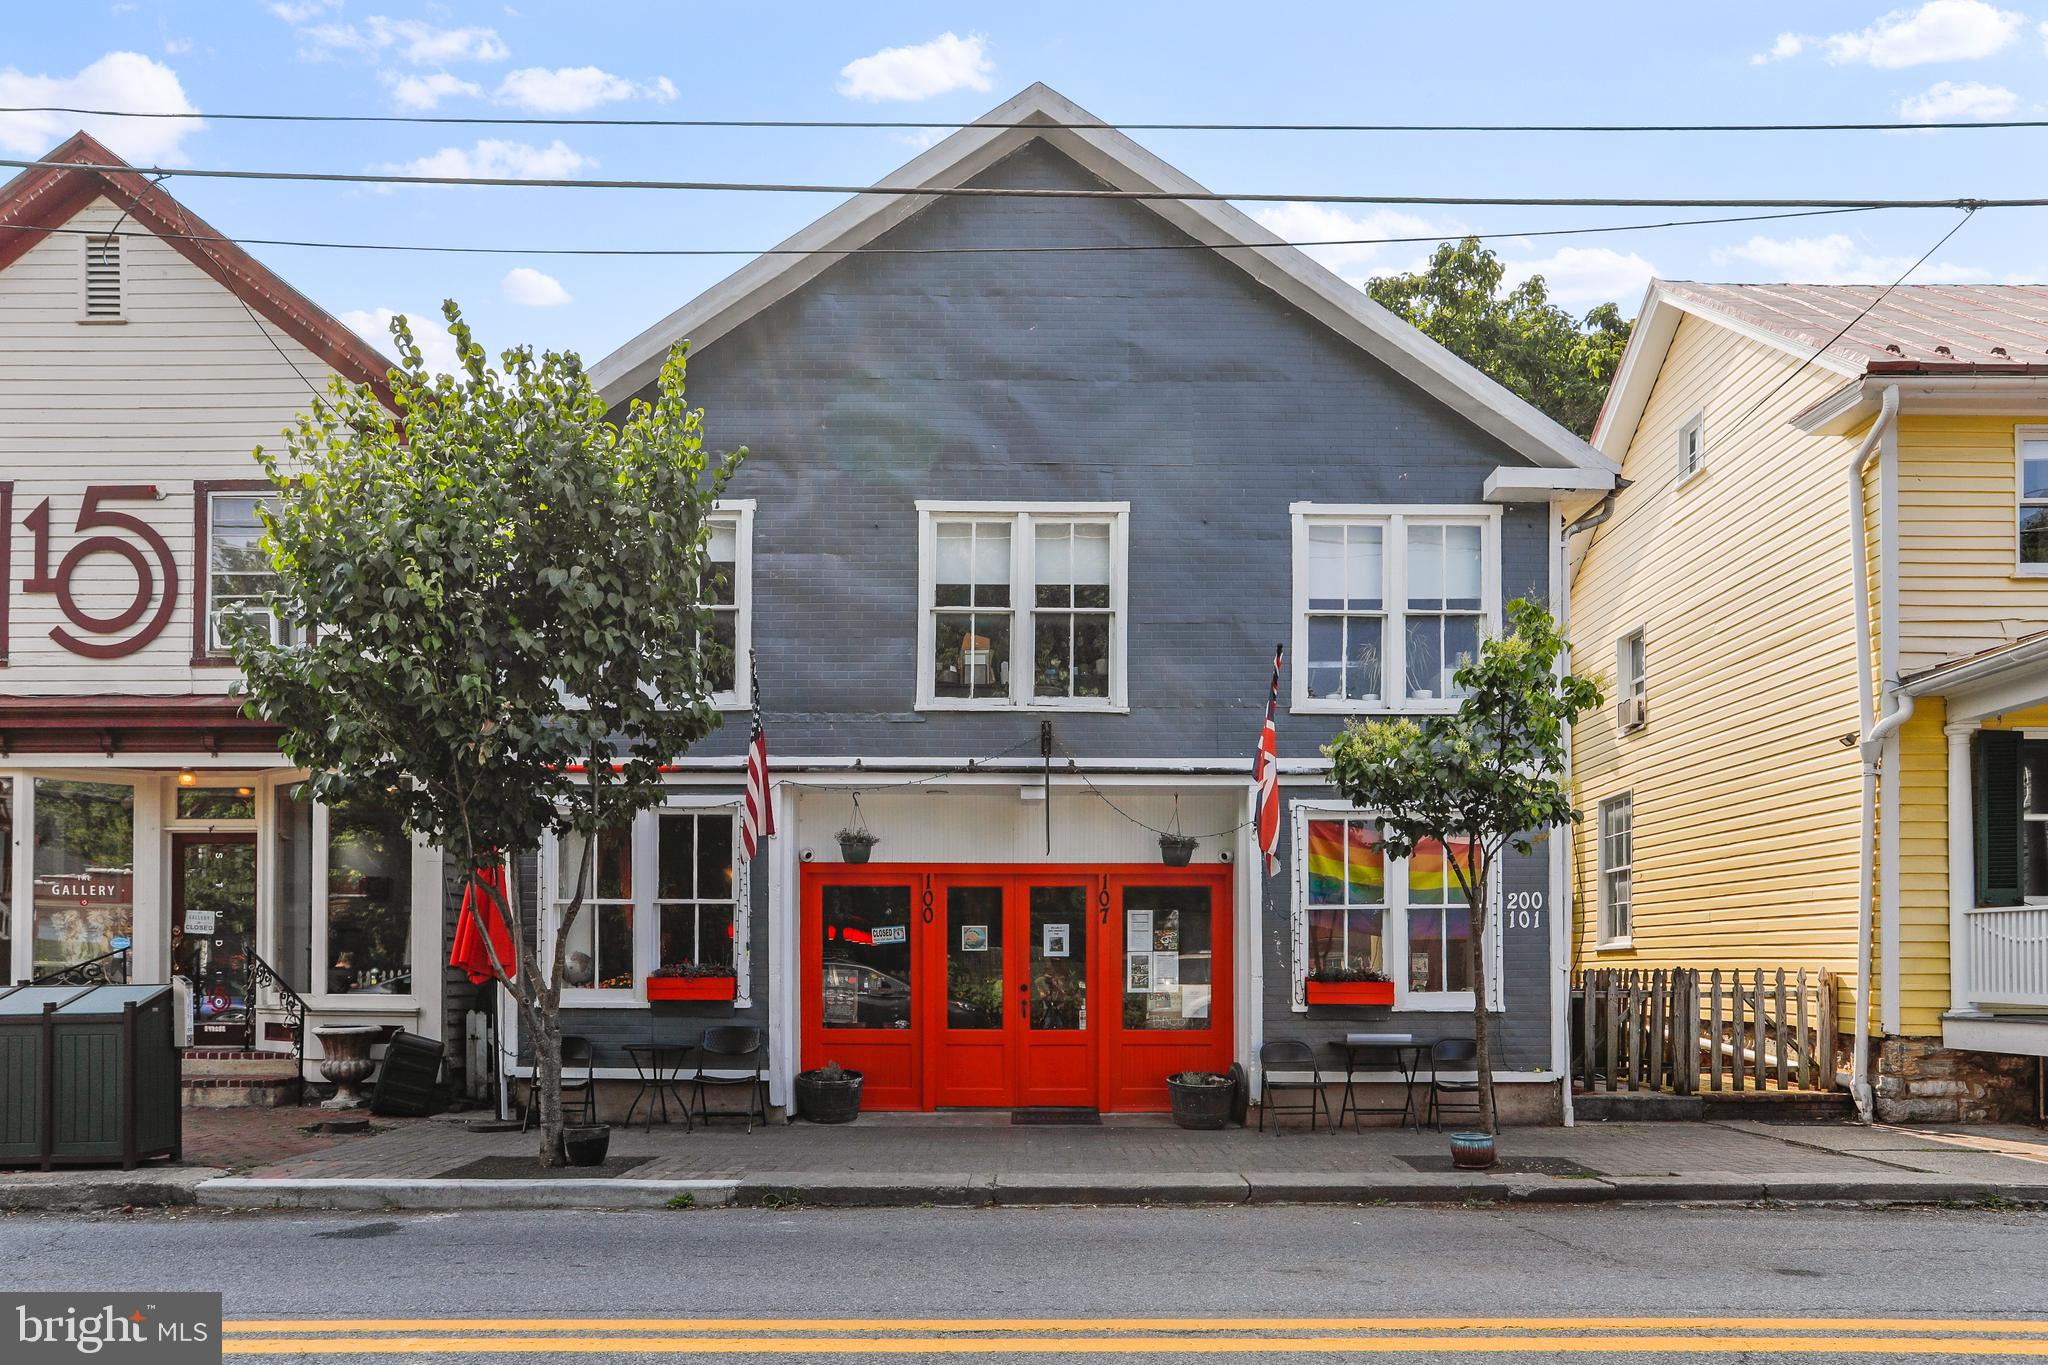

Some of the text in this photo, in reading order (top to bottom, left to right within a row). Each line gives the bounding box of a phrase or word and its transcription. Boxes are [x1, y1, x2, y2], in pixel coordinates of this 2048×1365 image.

[51, 884, 115, 896] GALLERY
[923, 873, 934, 924] 100
[1099, 874, 1110, 925] 107
[1506, 891, 1543, 910] 200
[1509, 910, 1540, 929] 101
[872, 928, 893, 938] CLOSED
